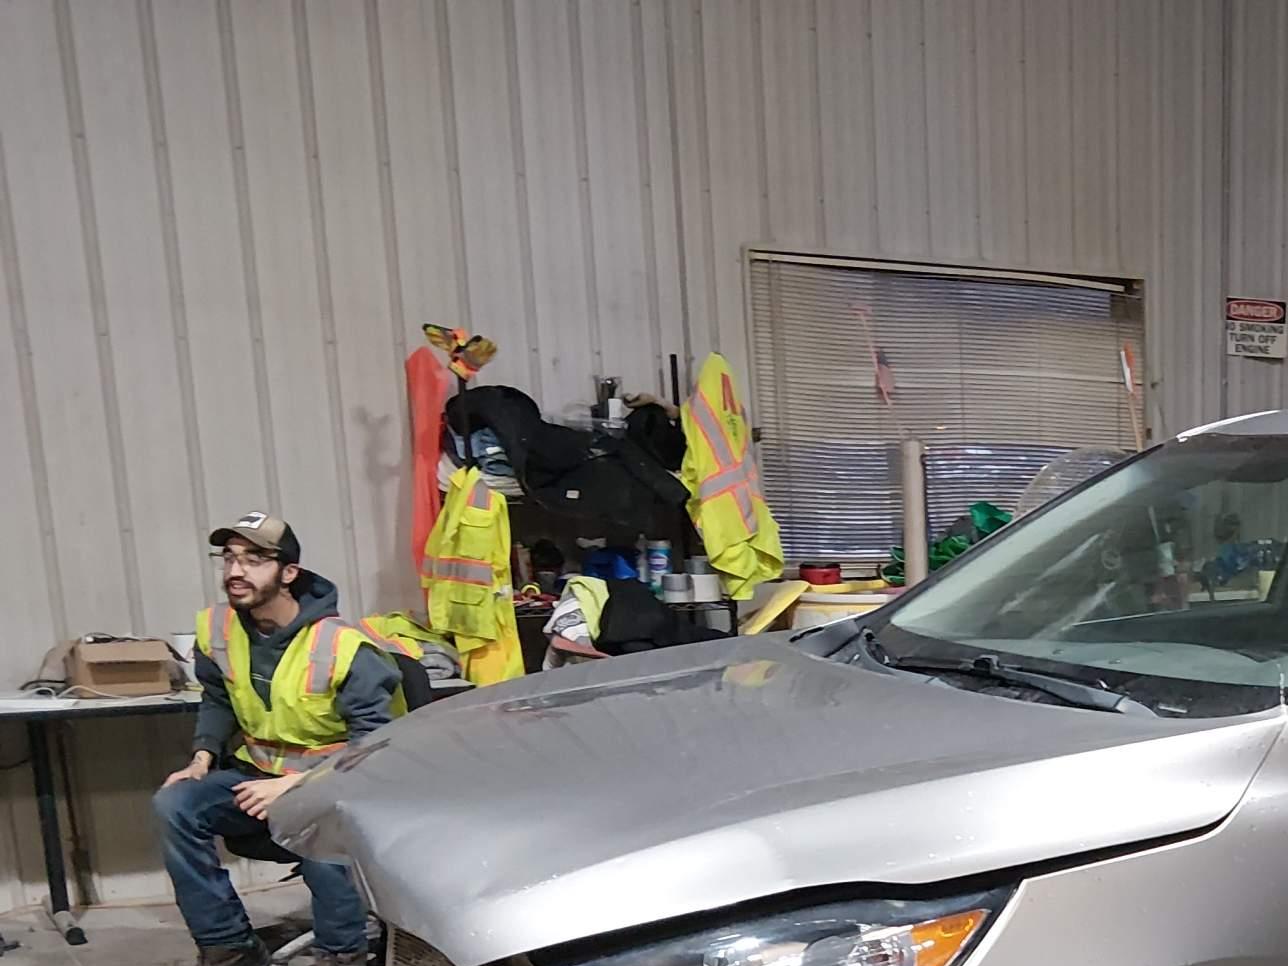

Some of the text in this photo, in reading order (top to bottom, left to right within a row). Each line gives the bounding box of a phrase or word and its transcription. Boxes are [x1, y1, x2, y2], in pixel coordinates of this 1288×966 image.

[1230, 303, 1278, 318] DANGER
[1240, 323, 1284, 335] SMOKING
[1230, 333, 1278, 344] TURN OFF
[1235, 344, 1271, 355] ENGINE
